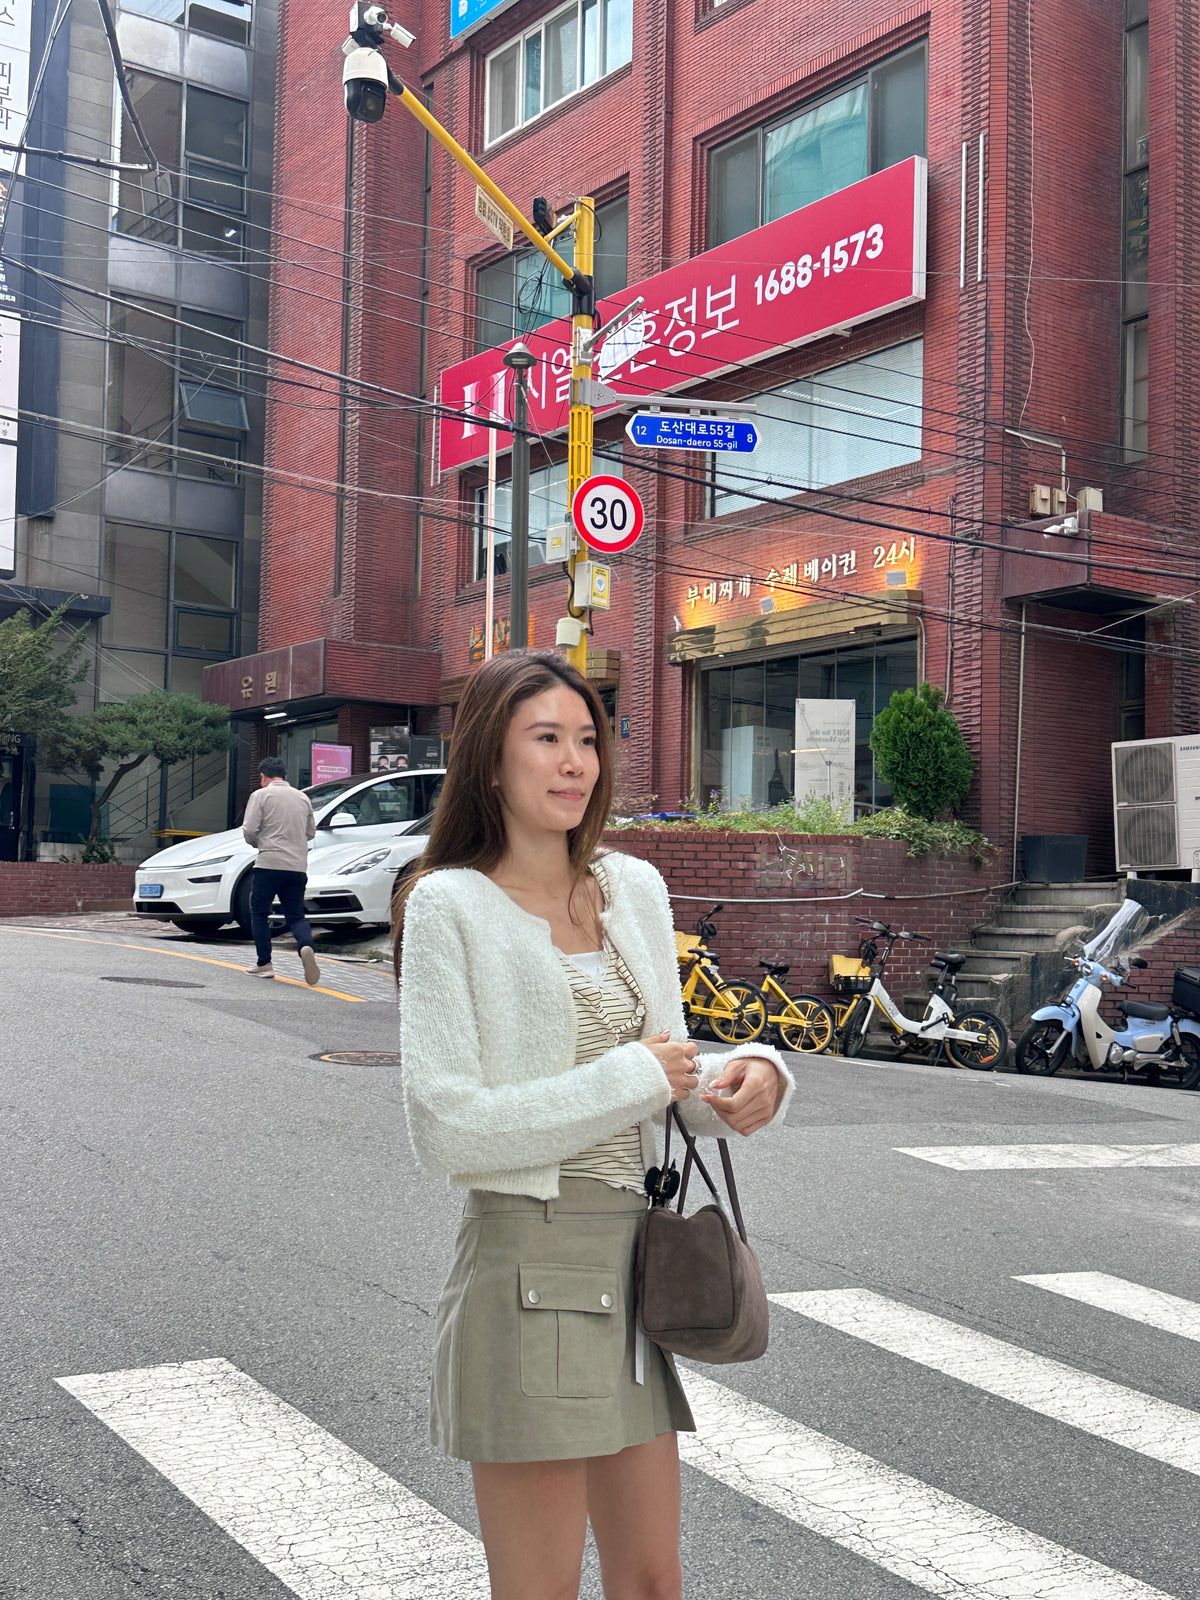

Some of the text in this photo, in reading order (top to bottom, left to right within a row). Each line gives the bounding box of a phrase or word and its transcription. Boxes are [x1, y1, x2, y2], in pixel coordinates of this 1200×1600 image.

[753, 223, 884, 305] 1688-1573
[635, 420, 735, 439] 12 도산대로55길
[656, 433, 754, 450] Dosan-daero 55-gil 8
[590, 496, 628, 532] 30
[763, 562, 798, 593] 수제
[803, 549, 858, 583] 베이컨
[873, 536, 915, 570] 24시
